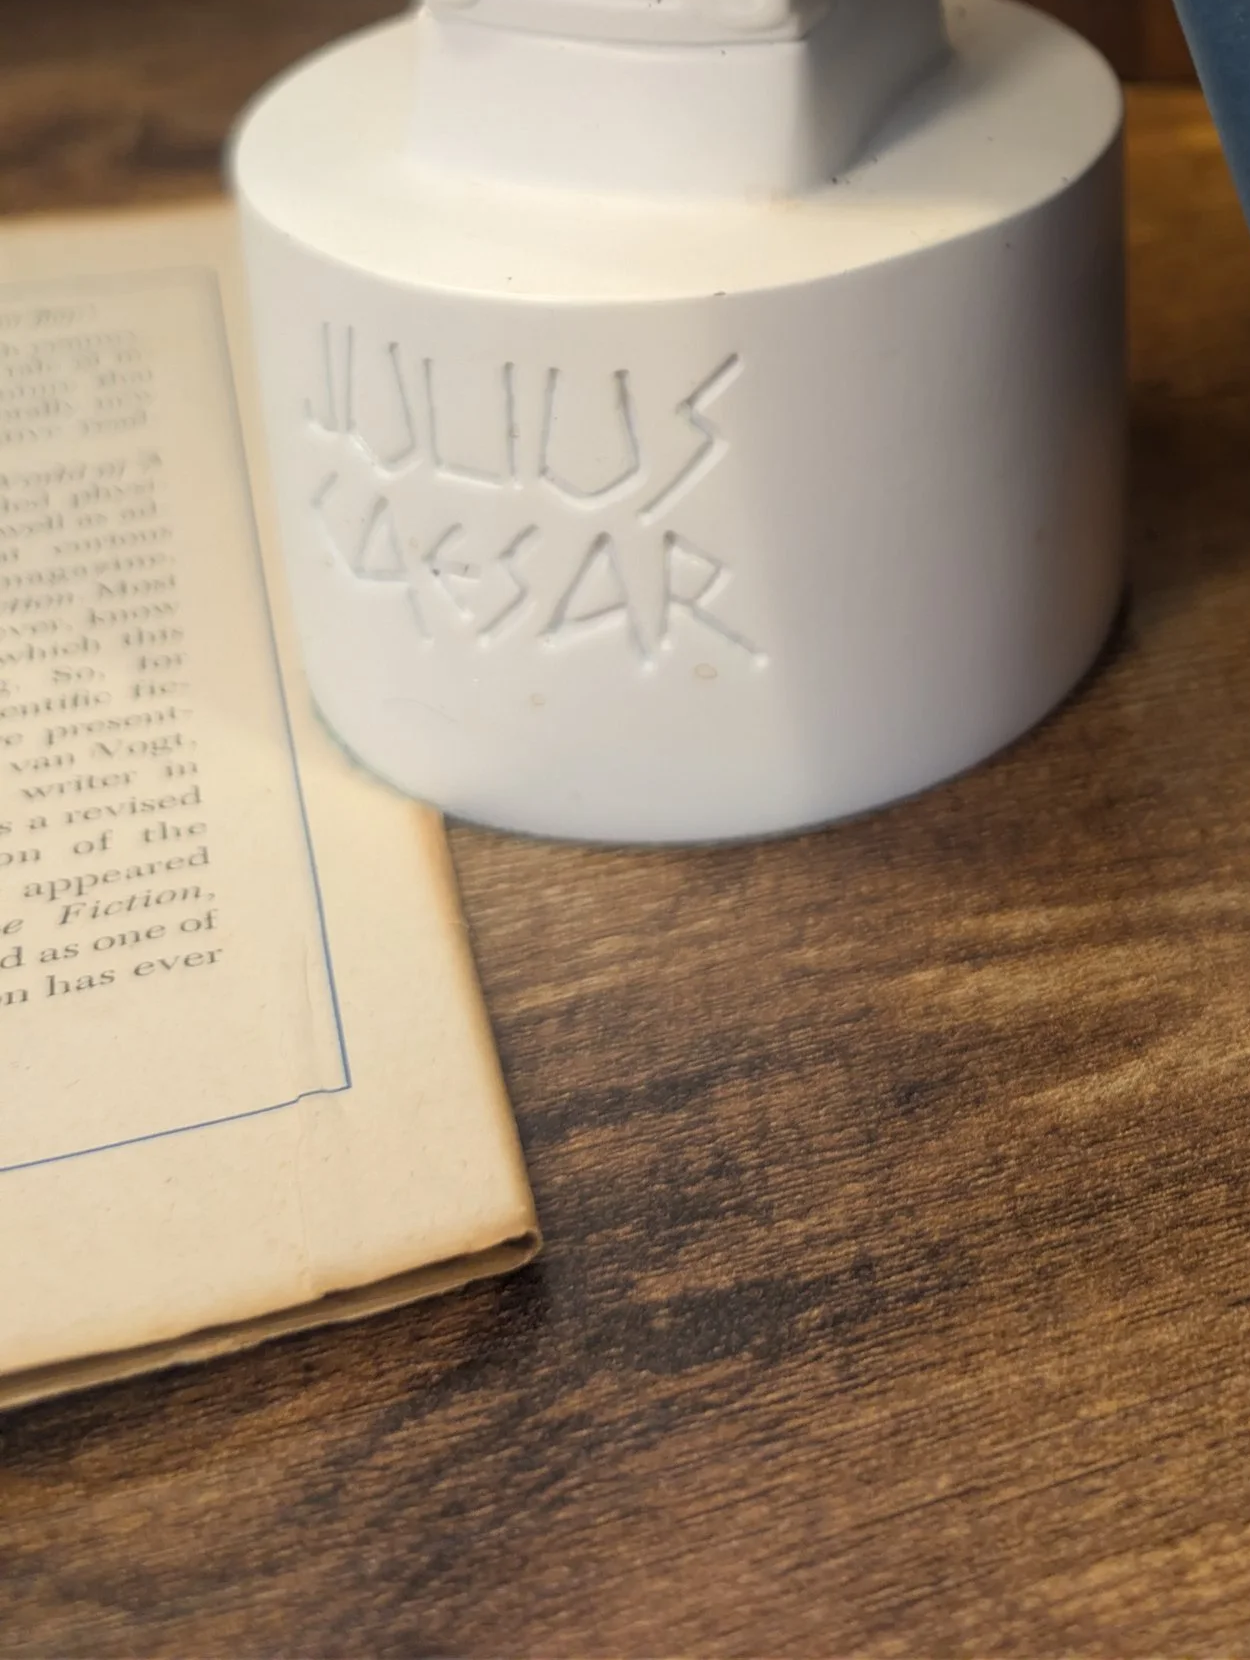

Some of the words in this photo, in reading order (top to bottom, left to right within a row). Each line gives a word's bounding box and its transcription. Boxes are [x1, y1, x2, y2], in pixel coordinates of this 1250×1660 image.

[302, 320, 742, 524] JULIUS
[308, 471, 768, 673] CAESAR
[9, 751, 75, 773] van
[91, 731, 198, 759] Vogt,
[21, 769, 138, 800] writer
[164, 759, 199, 779] in
[27, 813, 48, 831] a
[63, 784, 202, 825] revised
[72, 828, 114, 856] of
[142, 819, 209, 845] the
[22, 845, 211, 903] appeared
[57, 883, 217, 927] Fiction,
[39, 941, 80, 965] as
[92, 923, 168, 952] one
[179, 907, 219, 934] of
[45, 968, 117, 999] has
[132, 948, 224, 978] ever
